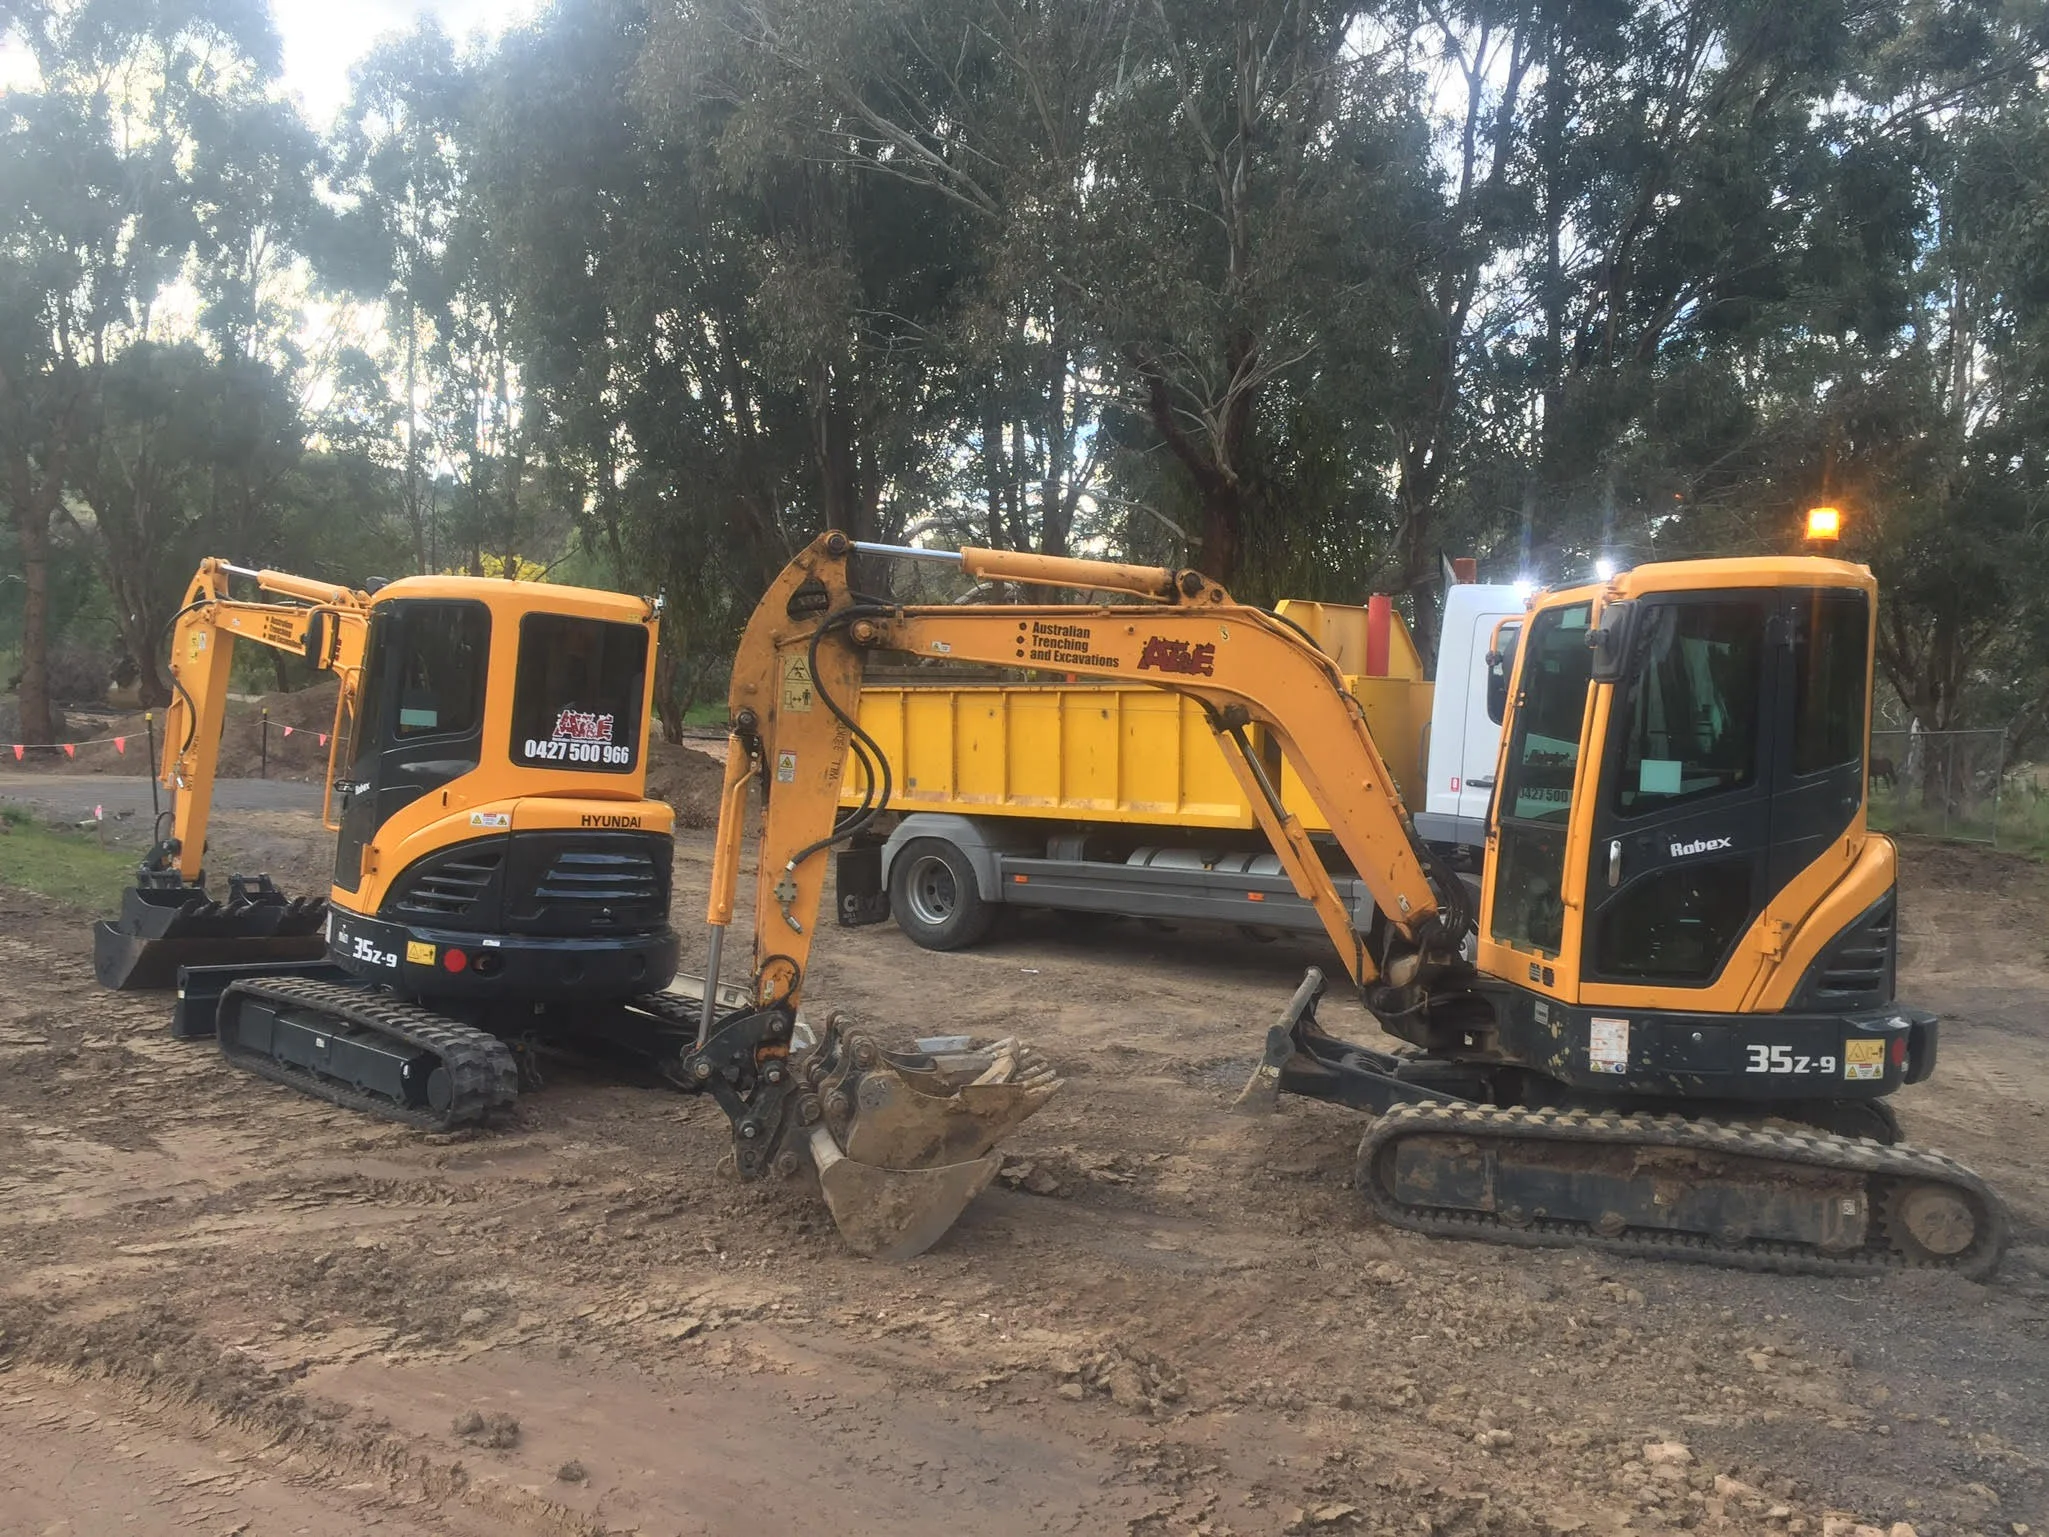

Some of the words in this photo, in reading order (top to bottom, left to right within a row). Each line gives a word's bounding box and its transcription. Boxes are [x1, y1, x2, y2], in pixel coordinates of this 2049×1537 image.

[1032, 621, 1090, 639] Australian
[1032, 635, 1088, 653] Trenching
[1030, 649, 1050, 661] and
[1053, 650, 1119, 668] Excavations
[525, 740, 566, 760] 0427
[569, 743, 600, 762] 500
[603, 746, 630, 764] 966
[1545, 789, 1569, 803] 500
[581, 815, 642, 828] HYUNDAI
[1670, 837, 1733, 858] Robex
